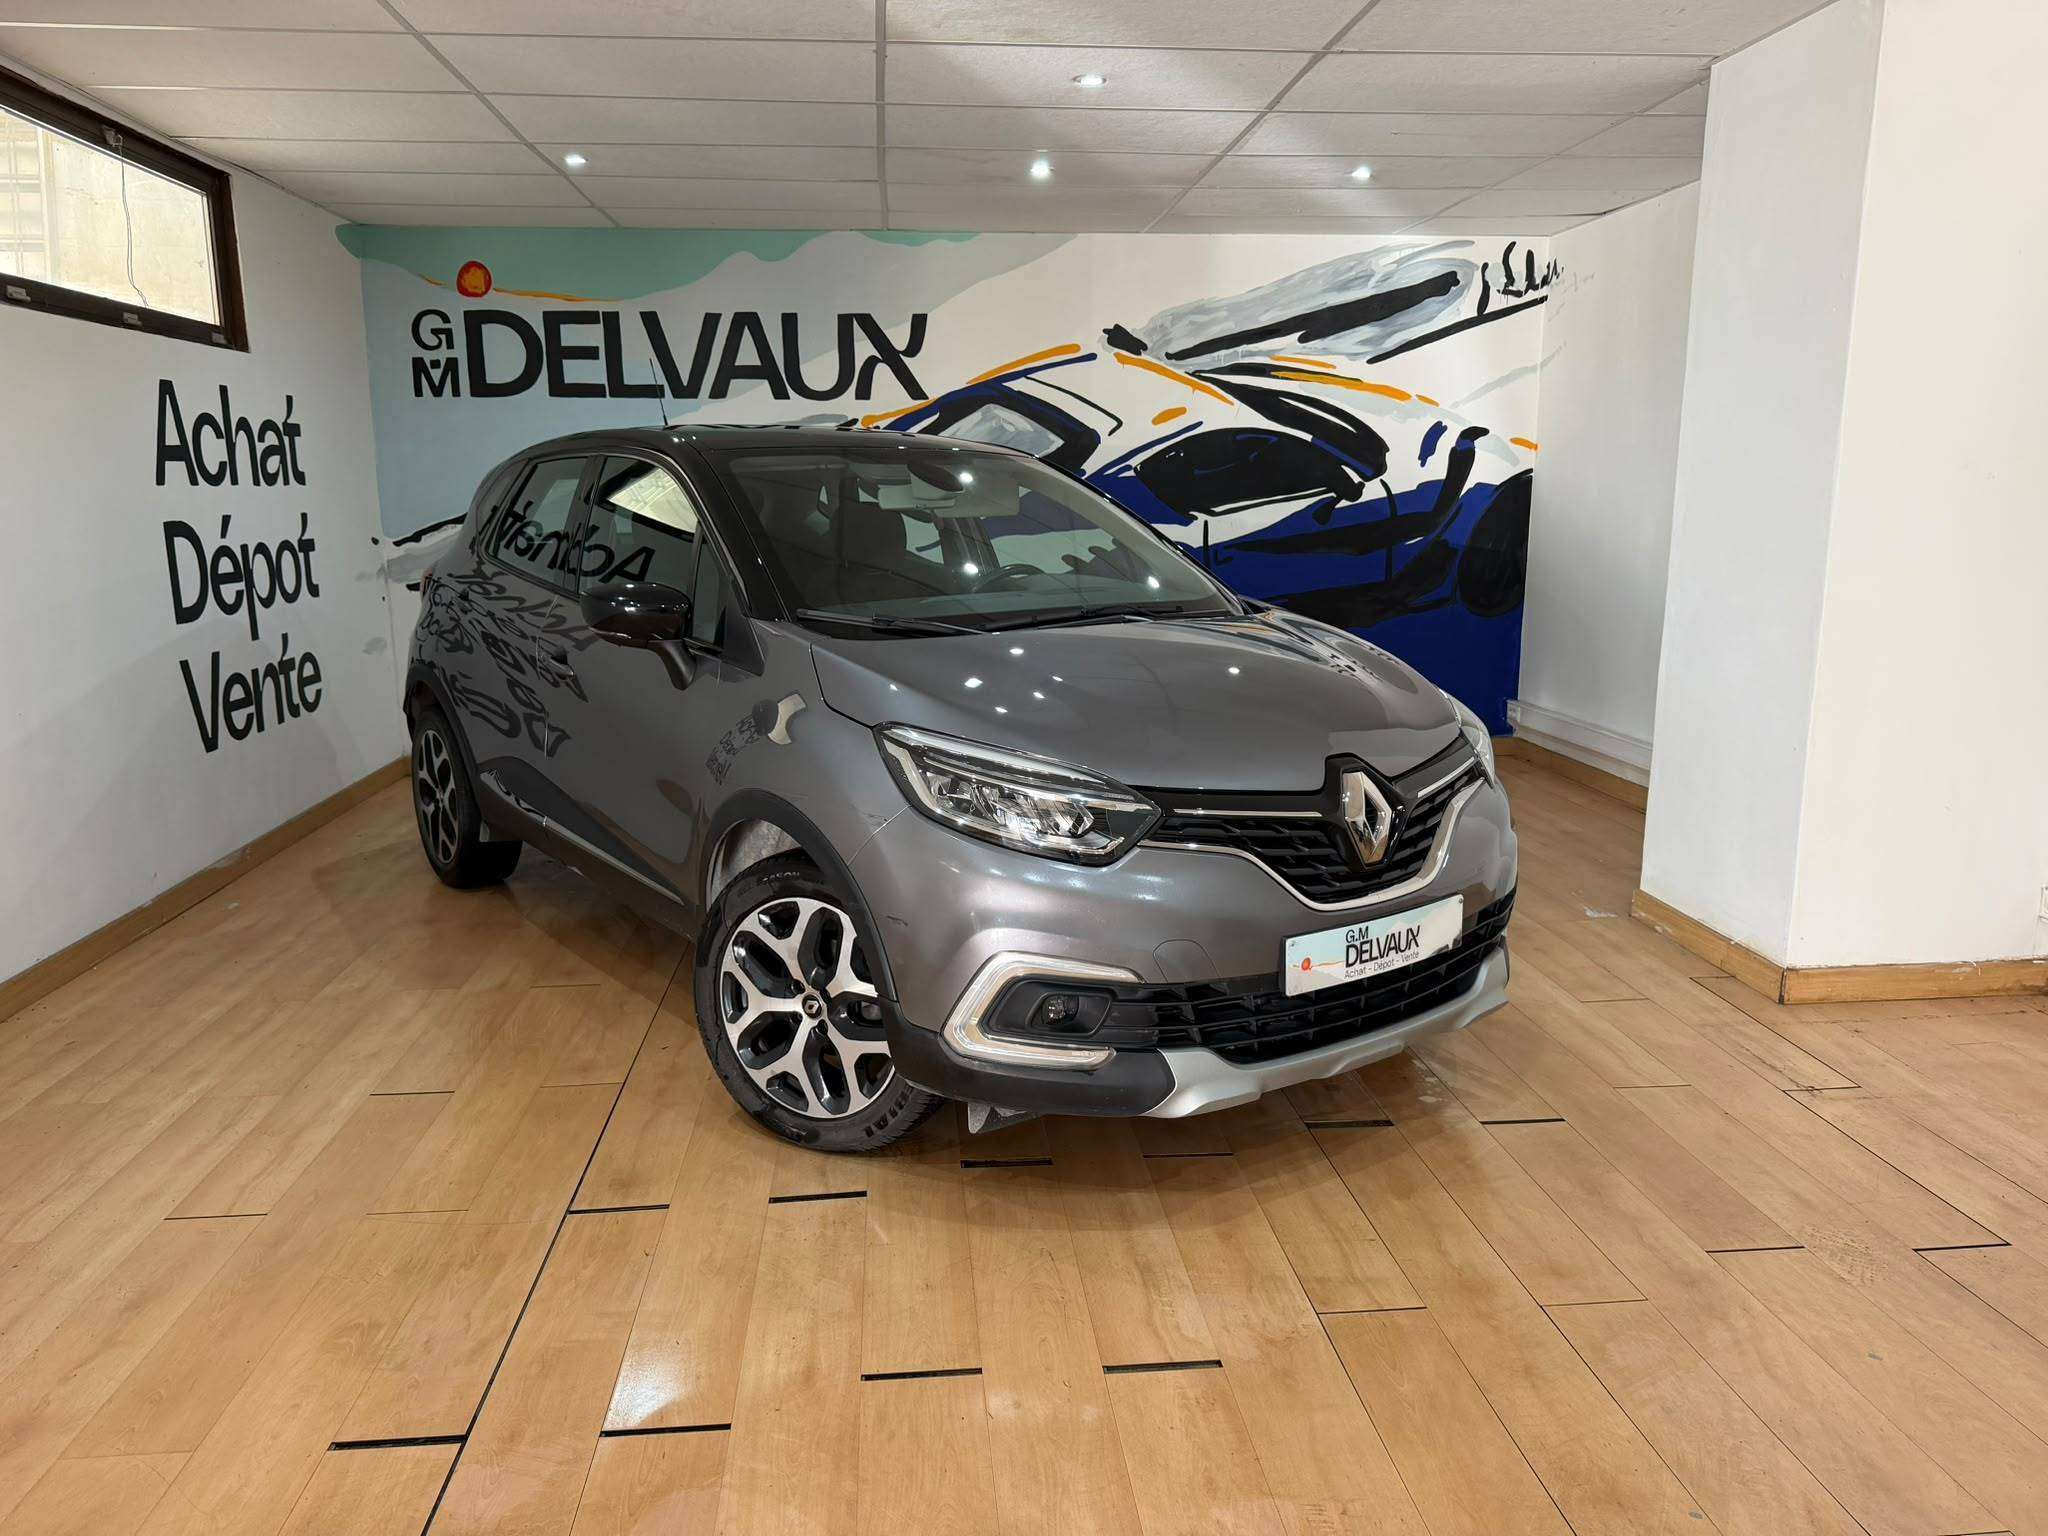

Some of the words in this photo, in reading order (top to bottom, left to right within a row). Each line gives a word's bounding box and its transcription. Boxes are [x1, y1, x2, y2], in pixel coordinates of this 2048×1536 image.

[463, 310, 928, 401] DELVAUX
[155, 378, 307, 487] Achat
[179, 632, 322, 753] Vente
[1344, 967, 1366, 979] Achat
[1401, 951, 1419, 963] Vente
[1345, 925, 1420, 968] DELVAUX
